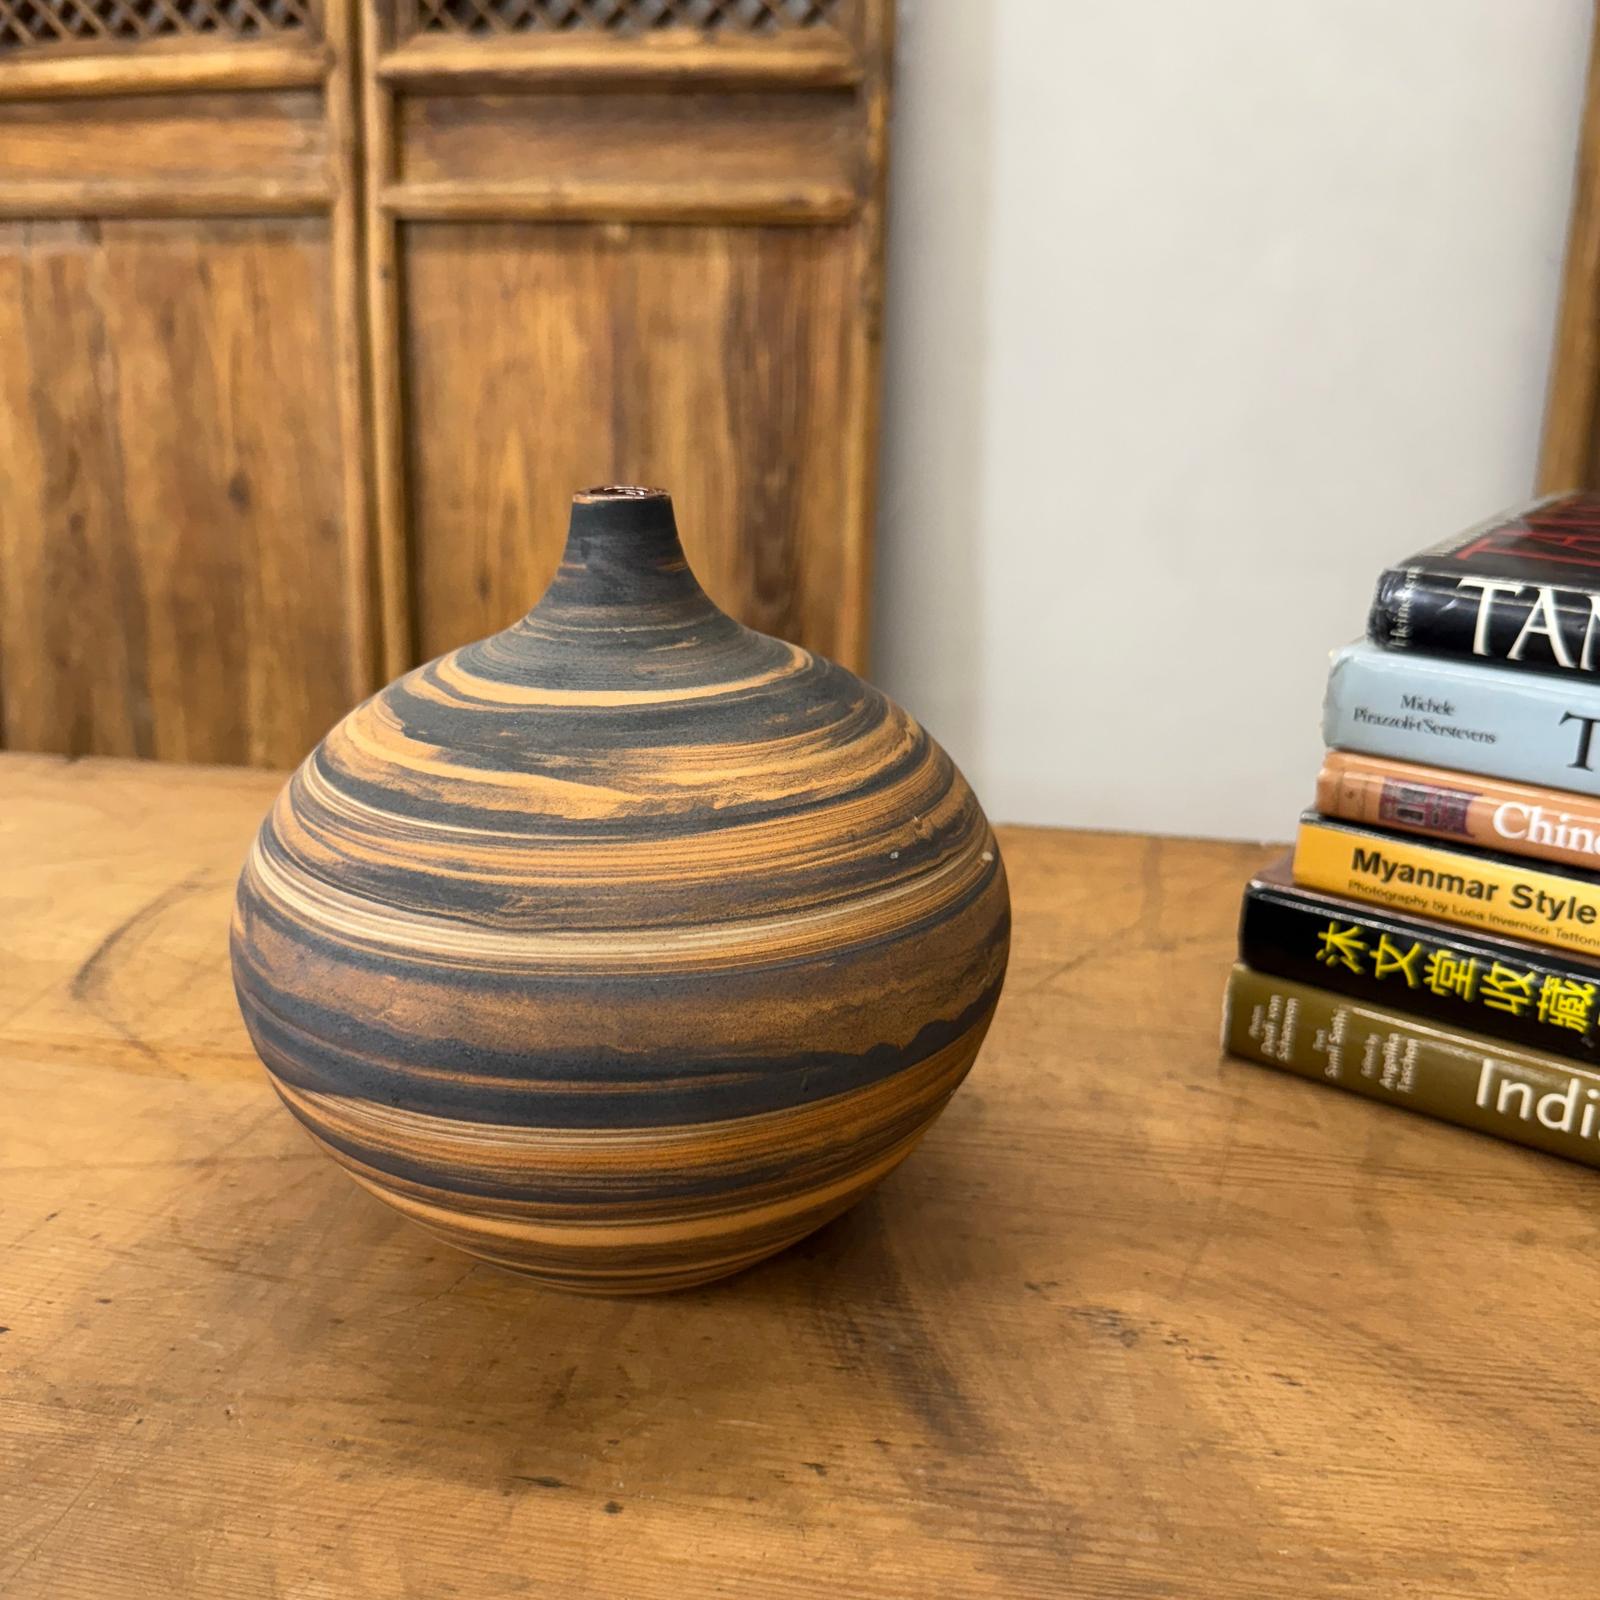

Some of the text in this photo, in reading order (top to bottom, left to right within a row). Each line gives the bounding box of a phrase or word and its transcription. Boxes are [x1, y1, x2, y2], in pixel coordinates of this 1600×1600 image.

[1492, 801, 1600, 855] Chin
[1348, 880, 1428, 907] Photography
[1432, 901, 1448, 913] by
[1452, 904, 1485, 920] Luca
[1352, 848, 1597, 924] Myanmar Style
[1315, 920, 1600, 1035] 沐文堂收藏
[1476, 1058, 1600, 1139] Indi
